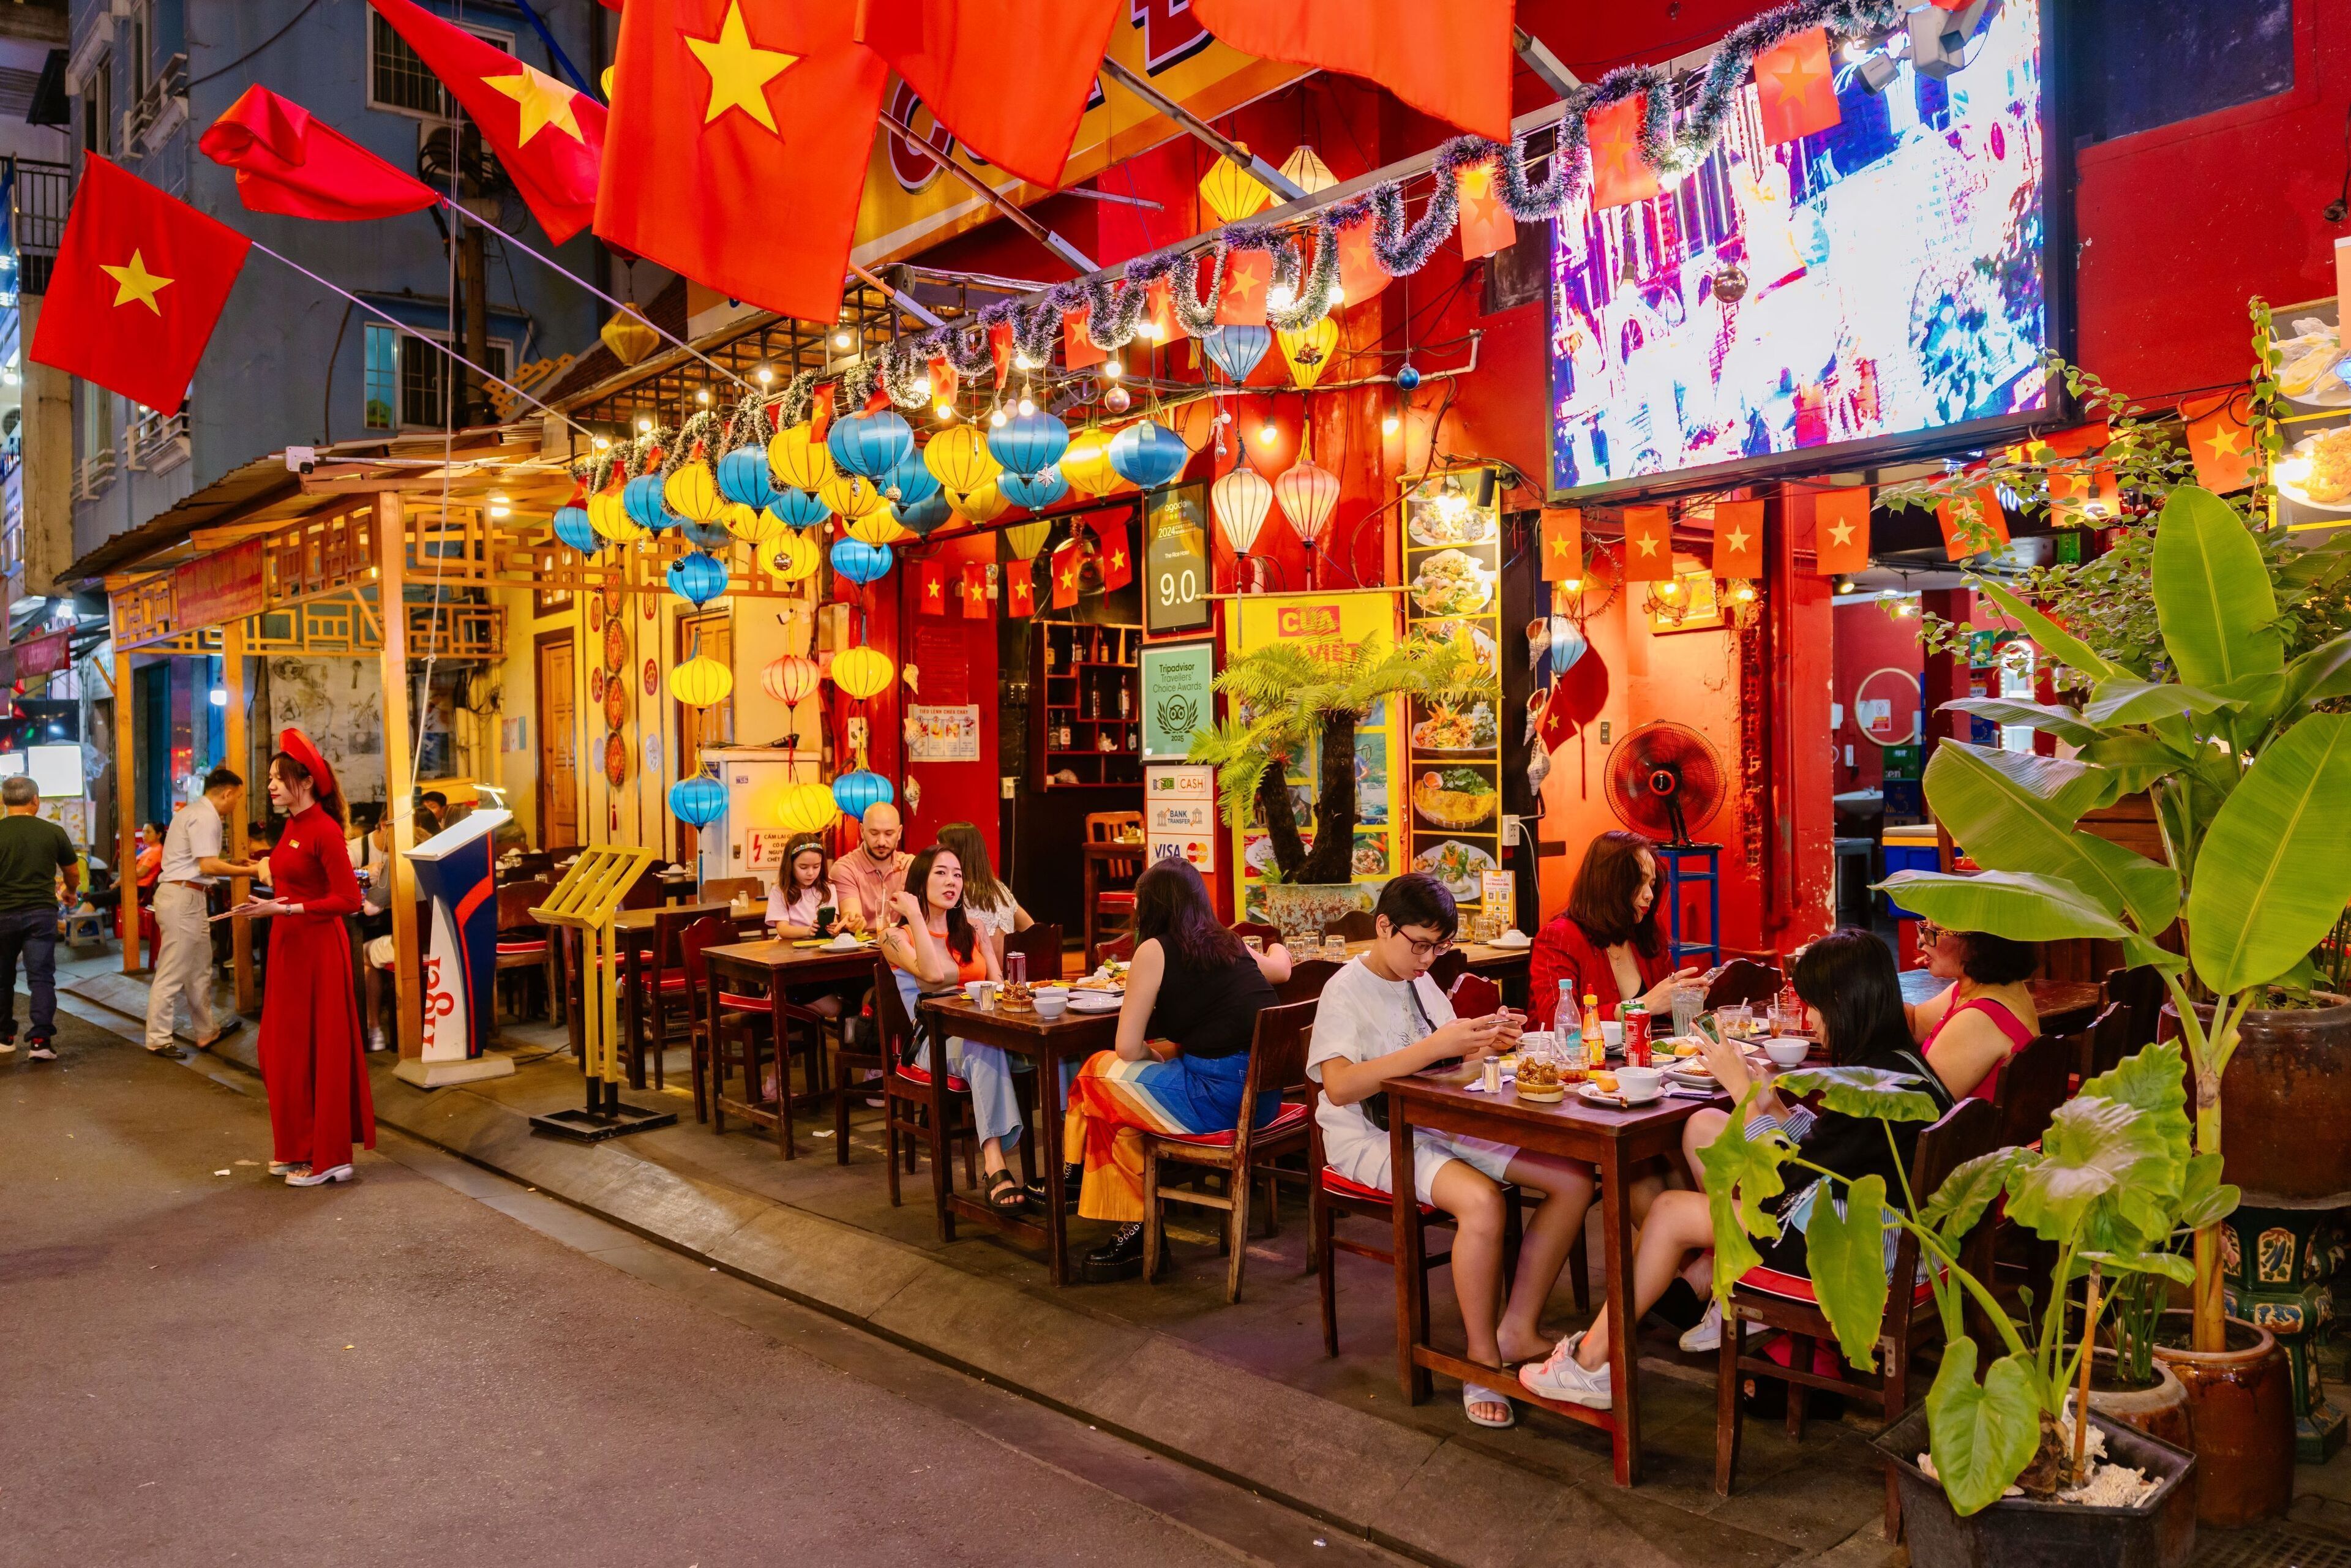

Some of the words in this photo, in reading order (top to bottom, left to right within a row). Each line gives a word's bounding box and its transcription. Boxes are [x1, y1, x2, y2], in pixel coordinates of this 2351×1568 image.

[1164, 500, 1187, 512] agoda
[1158, 525, 1175, 538] 2024
[1160, 569, 1196, 606] 9.0
[1159, 662, 1195, 674] Tripadvisor
[1153, 683, 1176, 693] Choice
[1177, 681, 1202, 691] Awards
[1180, 778, 1203, 789] CASH
[1153, 843, 1180, 858] VISA
